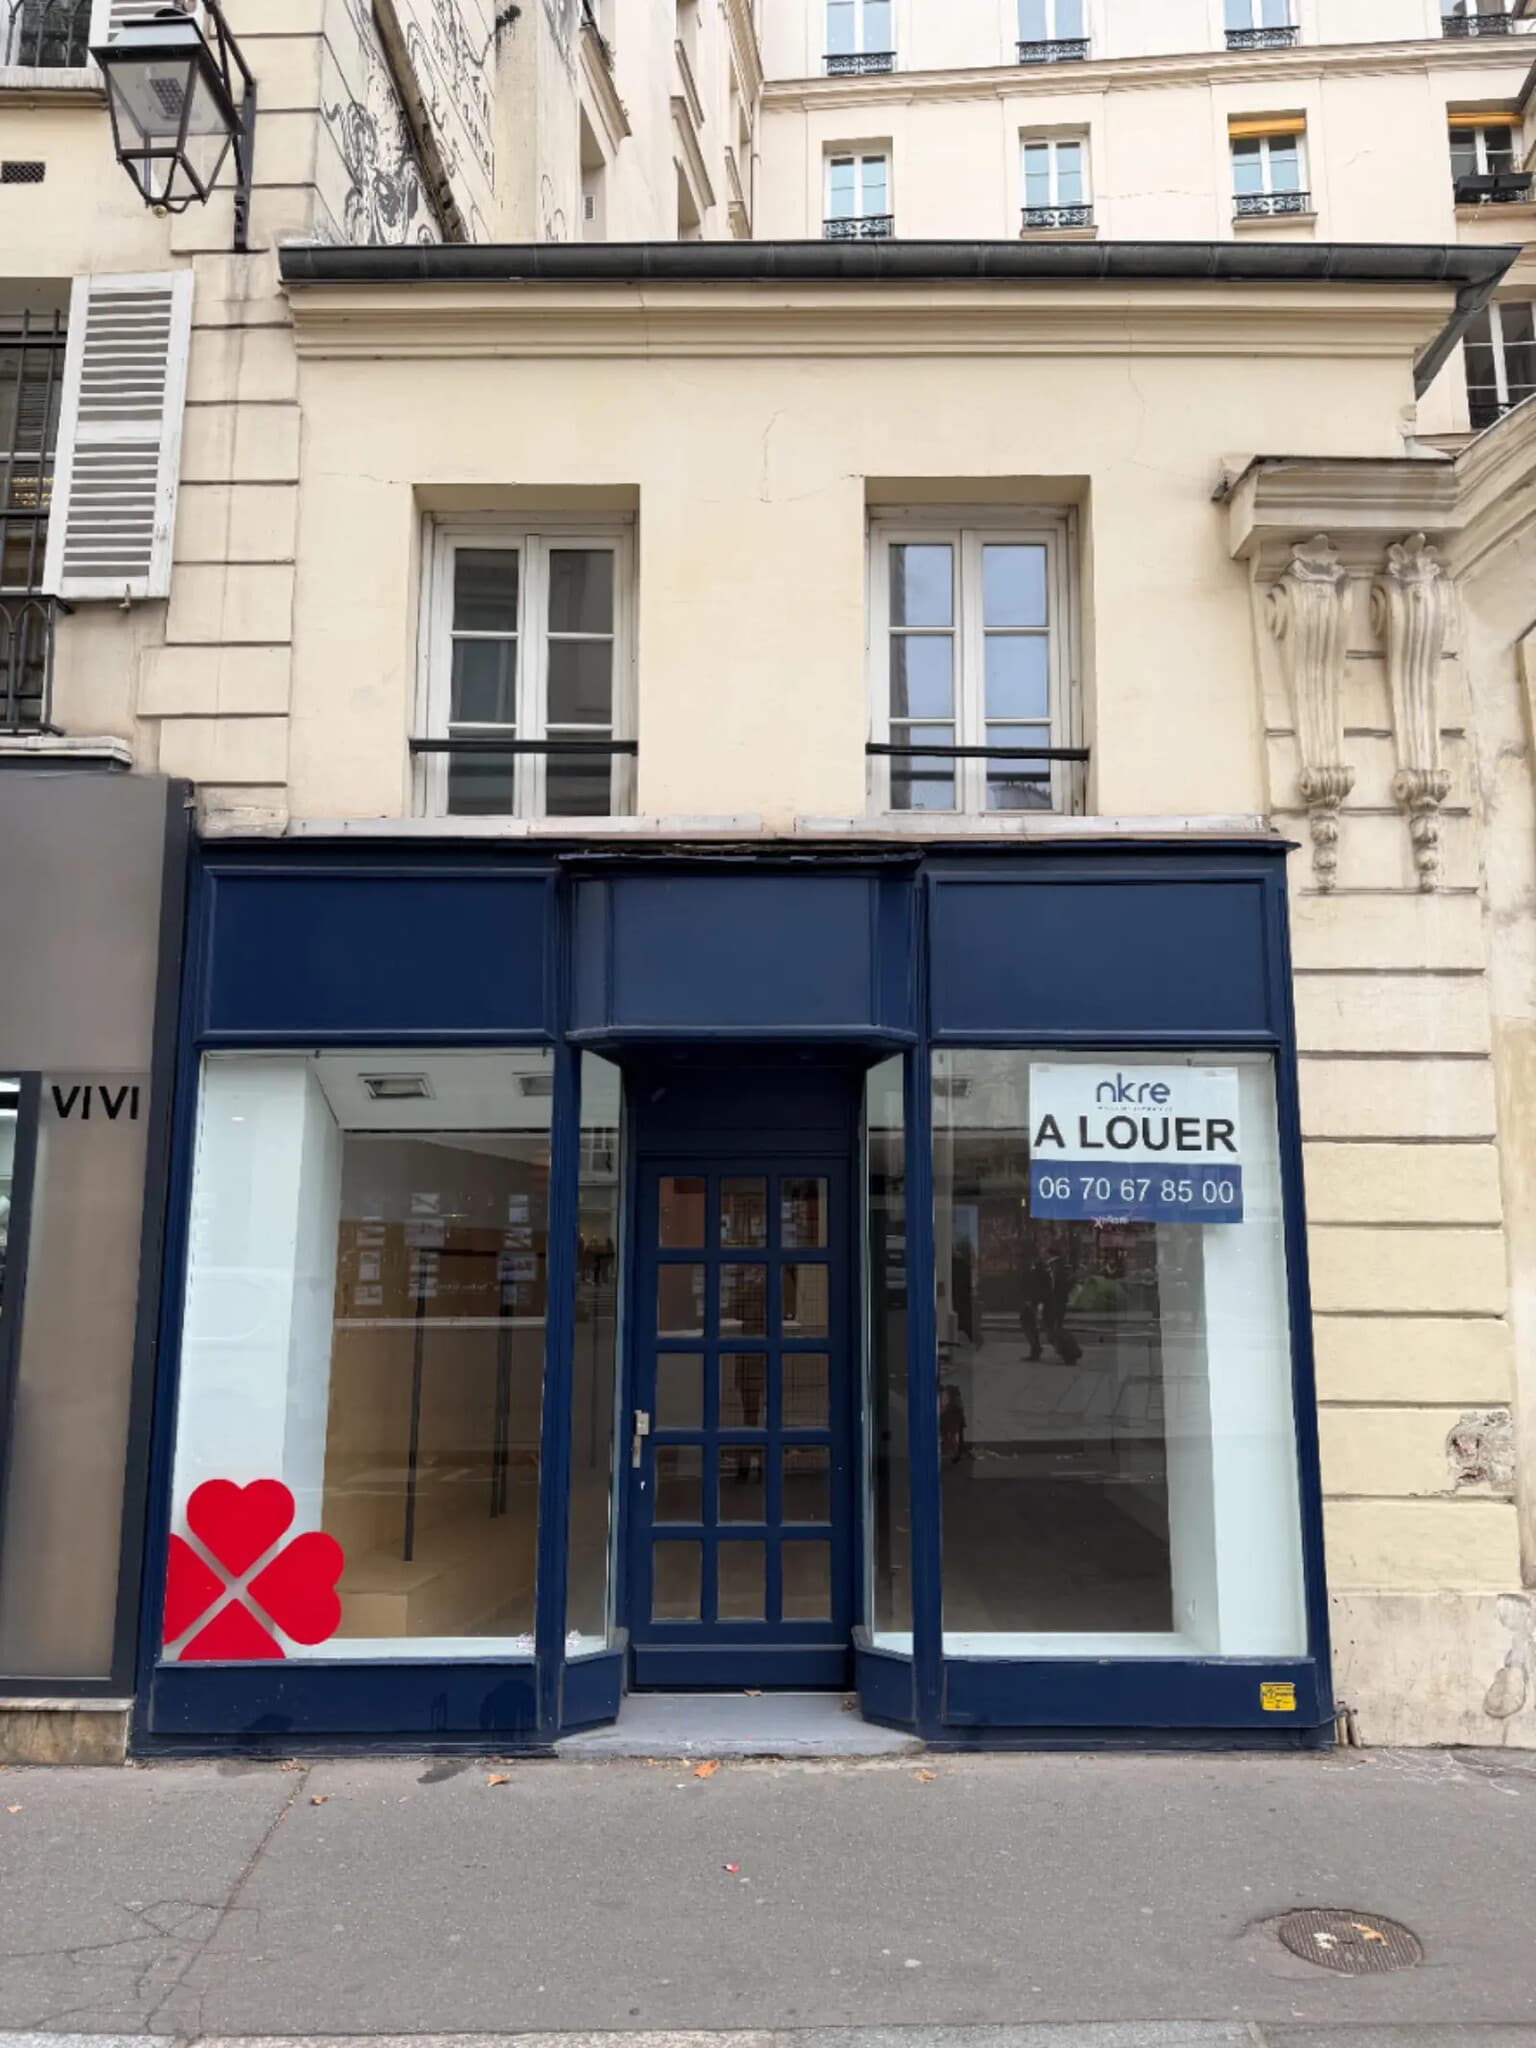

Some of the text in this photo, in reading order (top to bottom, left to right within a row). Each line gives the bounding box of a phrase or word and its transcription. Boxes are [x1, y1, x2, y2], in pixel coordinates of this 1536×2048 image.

[52, 1085, 139, 1119] VIVI
[1096, 1072, 1170, 1104] nkre
[1034, 1114, 1238, 1152] A LOUER
[1039, 1176, 1234, 1204] 06 70 67 85 00
